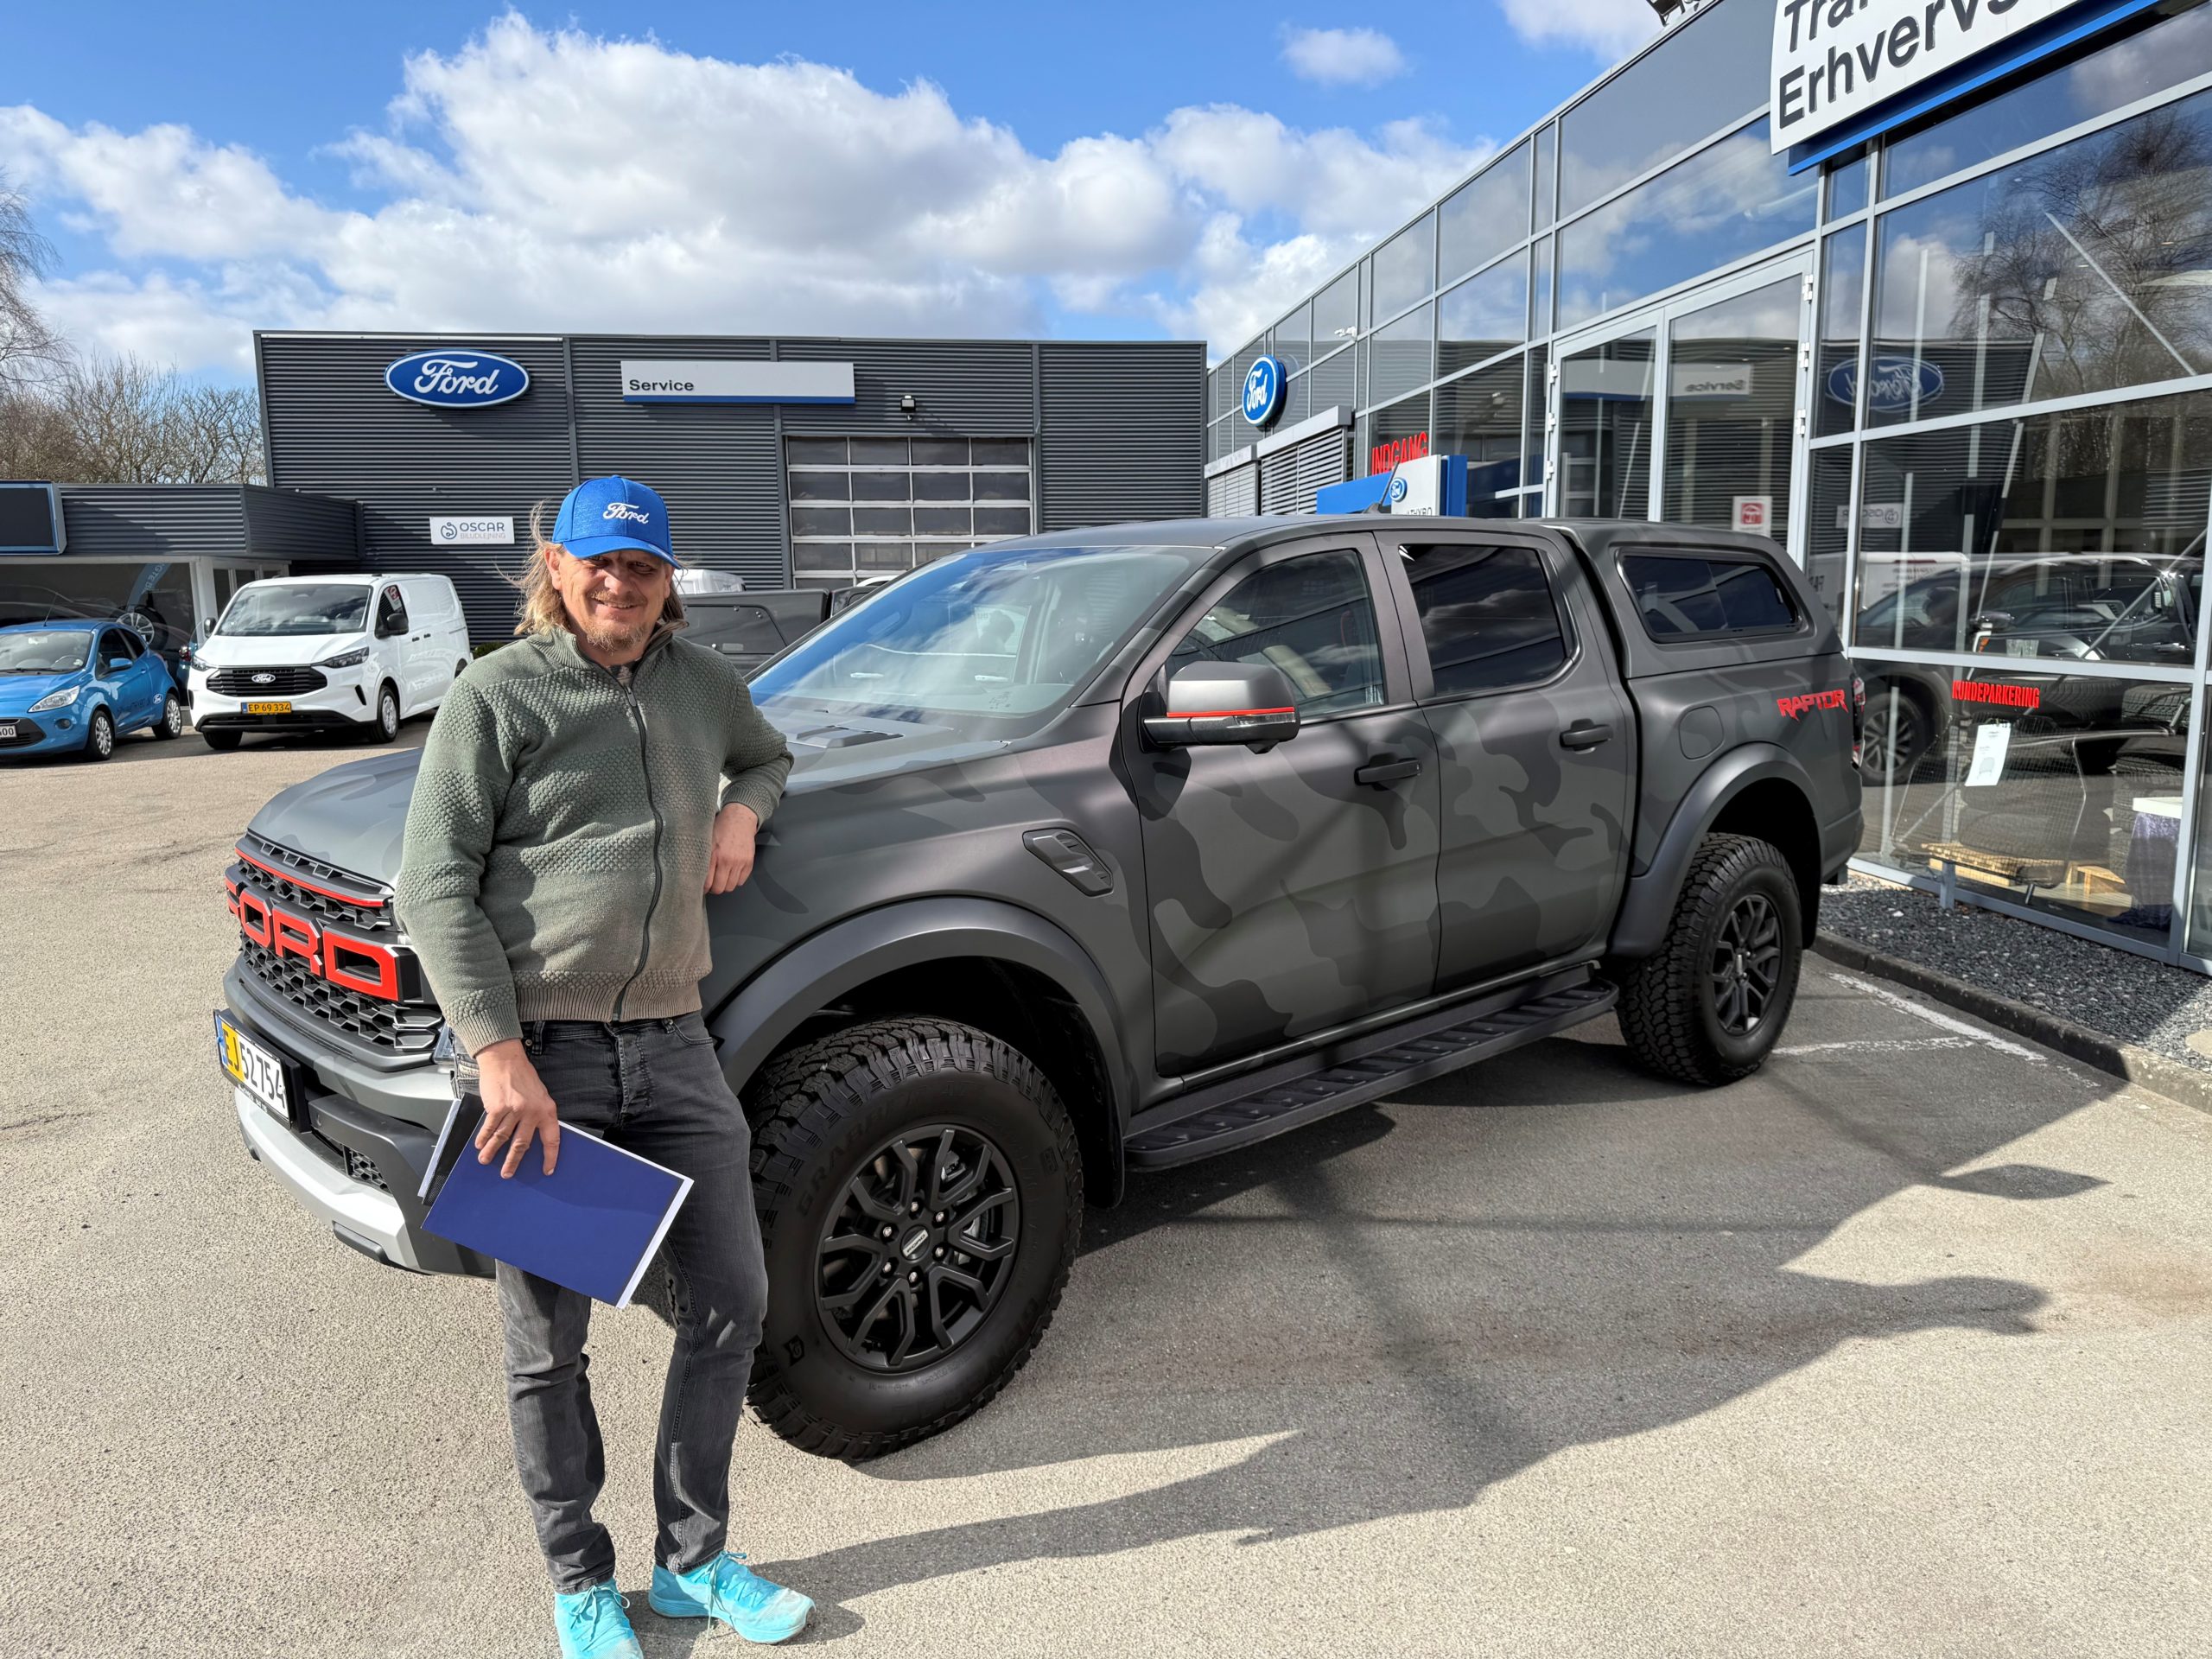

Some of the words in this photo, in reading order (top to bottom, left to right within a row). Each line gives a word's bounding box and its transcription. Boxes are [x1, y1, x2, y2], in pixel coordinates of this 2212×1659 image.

[414, 359, 499, 395] Ford
[629, 379, 694, 391] Service
[1246, 368, 1268, 412] Ford
[460, 522, 505, 532] OSCAR
[603, 502, 649, 524] Ford
[1777, 690, 1849, 722] RAPTOR
[1952, 680, 2040, 709] KUNDEPARKERING
